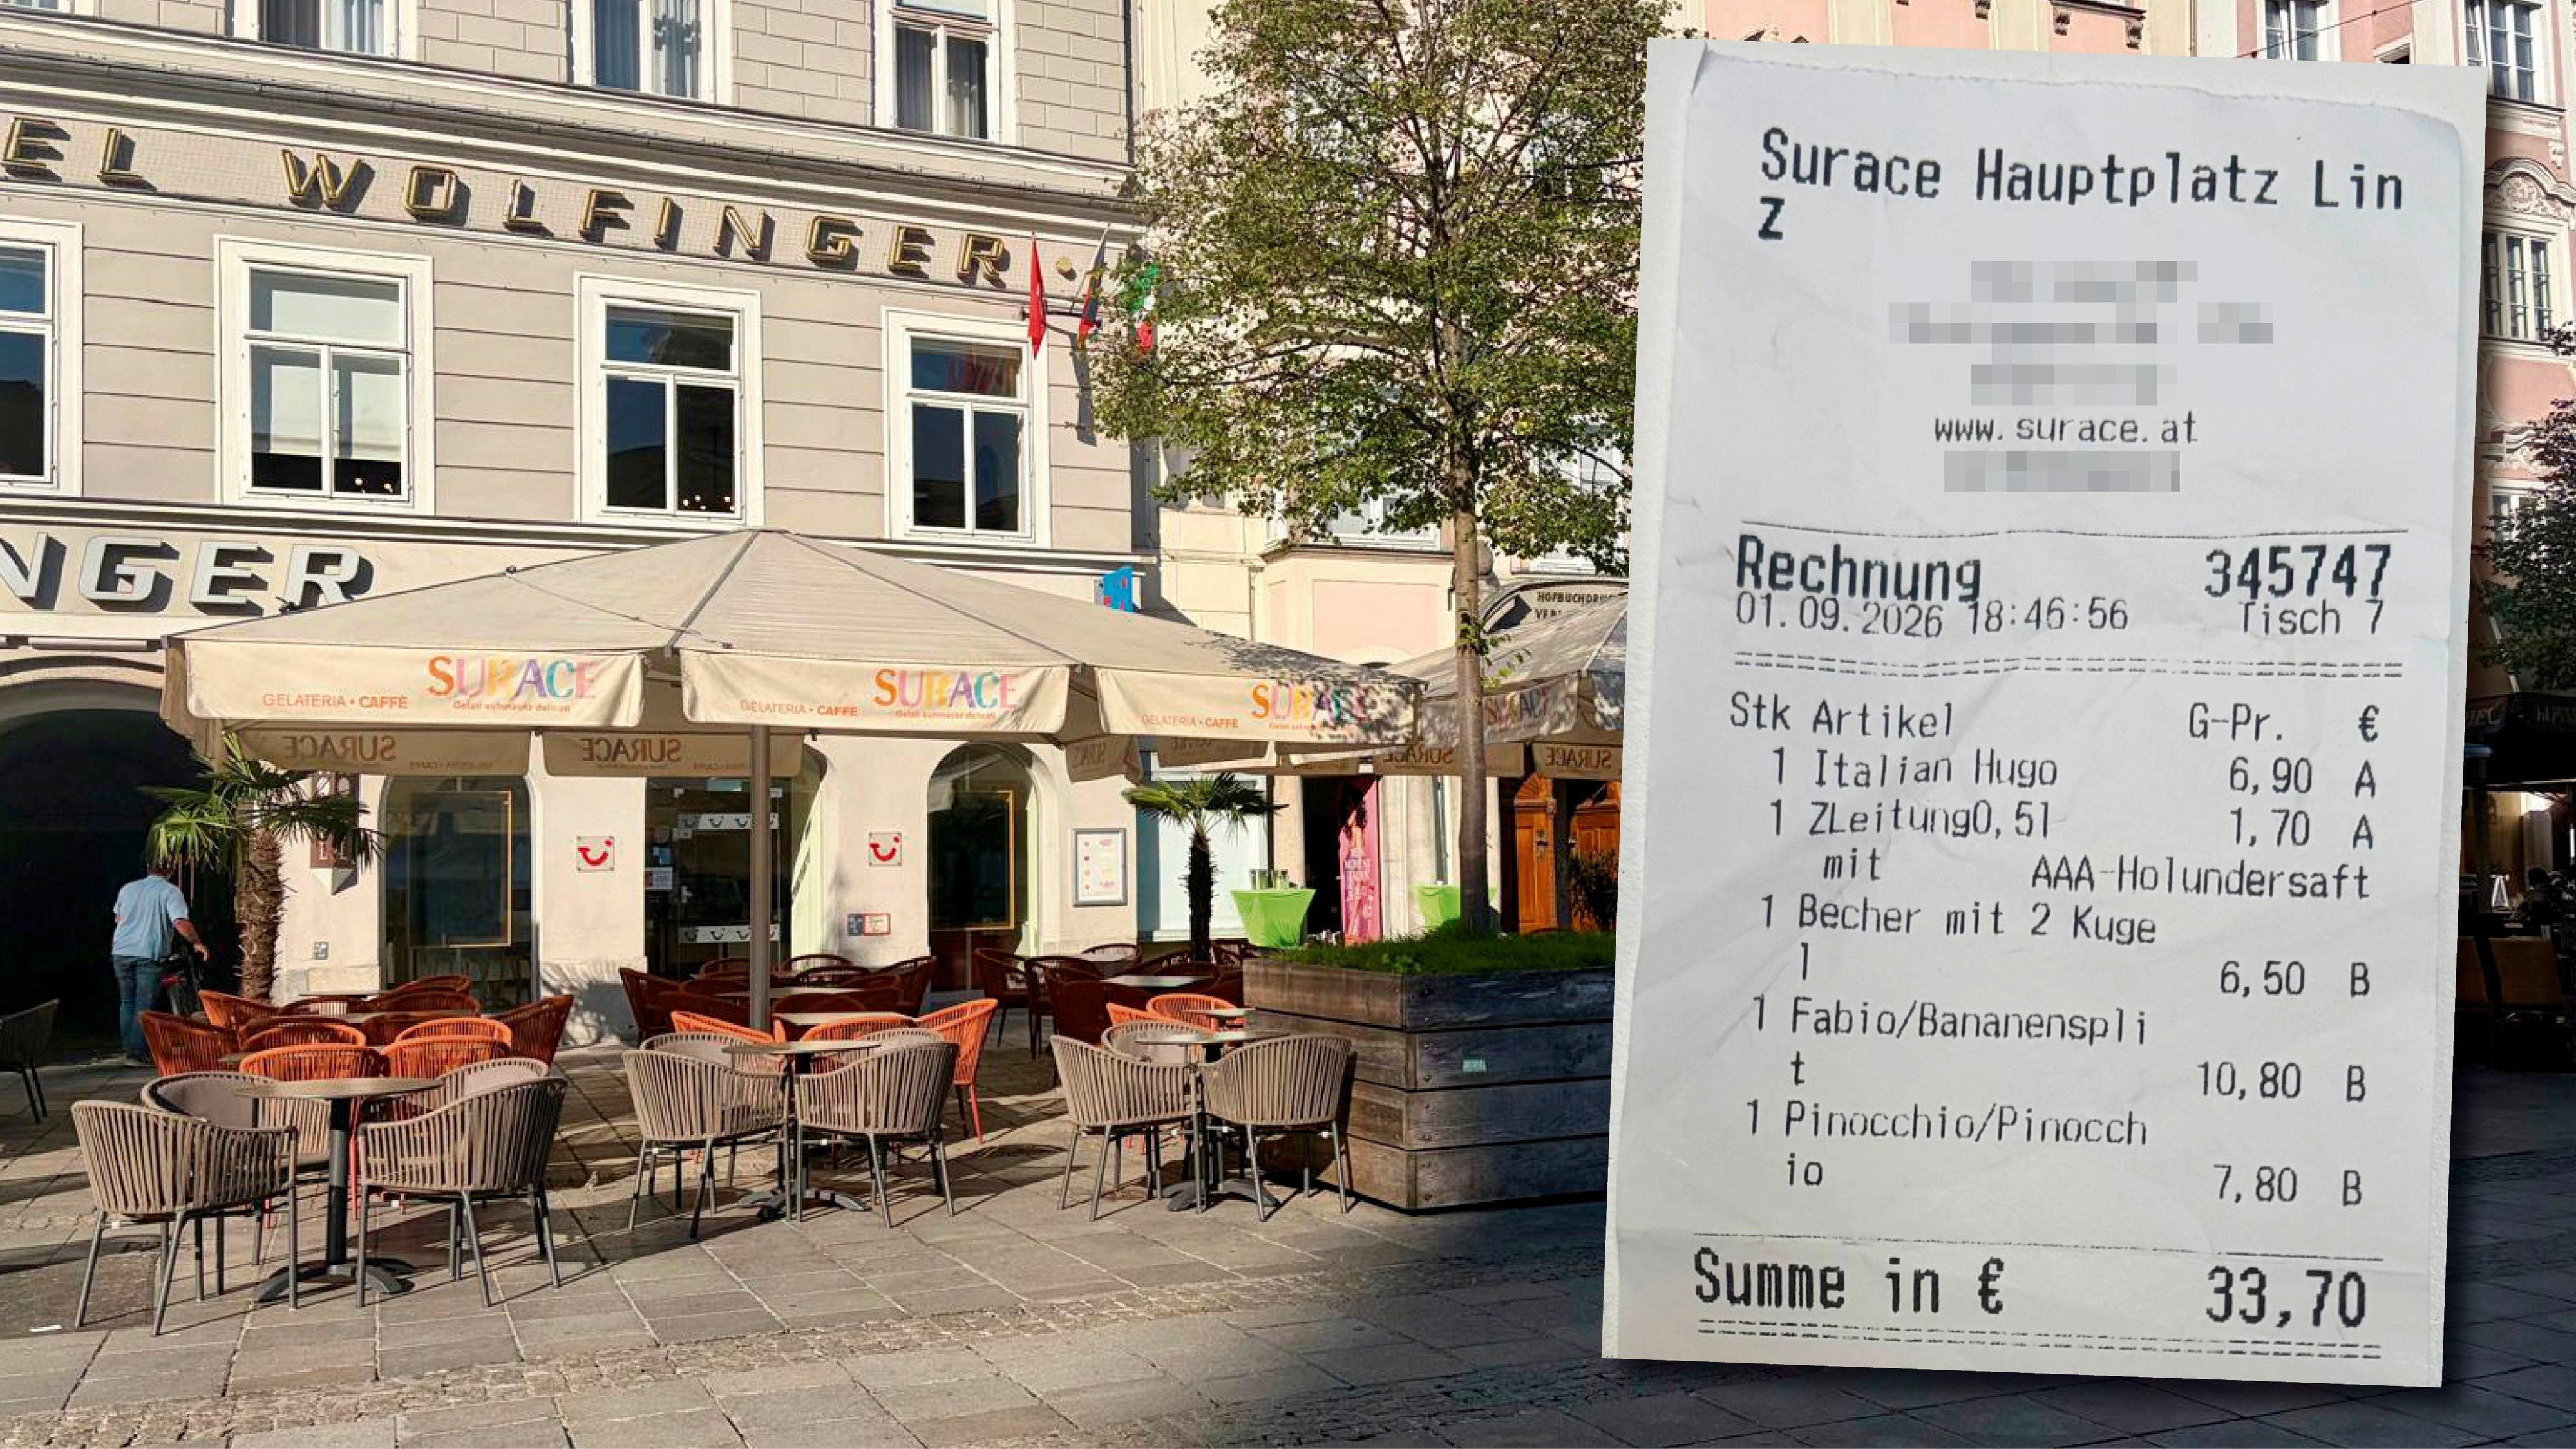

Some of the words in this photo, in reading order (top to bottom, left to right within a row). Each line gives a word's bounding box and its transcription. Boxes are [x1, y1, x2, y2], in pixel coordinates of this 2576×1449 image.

[1761, 126, 1941, 198] Surace
[1976, 147, 2278, 207] Hauptplatz
[2314, 159, 2403, 211] Lin
[1, 116, 148, 184] EL
[282, 149, 1009, 286] WOLFINGER
[1934, 412, 2198, 444] www.surace.at
[1736, 534, 1982, 603] Rechnung
[2204, 543, 2391, 600] 345747
[1736, 592, 1944, 638] 01.09.2026
[1967, 596, 2129, 635] 18:46:56
[2238, 596, 2341, 636] Tisch
[2365, 598, 2384, 635] 7
[262, 694, 346, 706] GELATERIA
[428, 655, 598, 698] SURACE
[741, 700, 805, 715] GELATERIA
[1730, 690, 1791, 732] Stk
[1812, 698, 1952, 739] Artikel
[2188, 701, 2282, 742] G-Pr.
[2358, 704, 2380, 743] €
[1772, 746, 1785, 785] 1
[1815, 748, 1952, 789] Italian
[1975, 750, 2058, 789] Hugo
[2229, 755, 2313, 796] 6,90
[2354, 761, 2376, 799] A
[1770, 798, 1782, 837] 1
[2230, 806, 2310, 848] 1,70
[2352, 813, 2374, 850] A
[1823, 847, 1881, 882] mit
[2031, 854, 2370, 900] AAA-Holundersaft
[1761, 894, 1774, 929] 1
[1798, 893, 1922, 934] Becher
[1946, 901, 2005, 936] mit
[2030, 902, 2051, 936] 2
[2072, 904, 2156, 946] Kuge
[2220, 960, 2306, 998] 6,50
[2349, 961, 2371, 998] B
[1753, 993, 1765, 1031] 1
[1792, 996, 2145, 1046] Fabio/Bananenspli
[1790, 1050, 1805, 1087] t
[2197, 1061, 2302, 1101] 10,80
[2345, 1064, 2366, 1103] B
[1747, 1099, 1759, 1135] 1
[1785, 1099, 2146, 1146] Pinocchio/Pinocch
[1786, 1153, 1823, 1187] io
[2213, 1164, 2297, 1204] 7,80
[2342, 1169, 2362, 1207] B
[1693, 1246, 1845, 1311] Summe
[1884, 1256, 1940, 1314] in
[1977, 1256, 2005, 1315] €
[2205, 1265, 2367, 1329] 33,70
